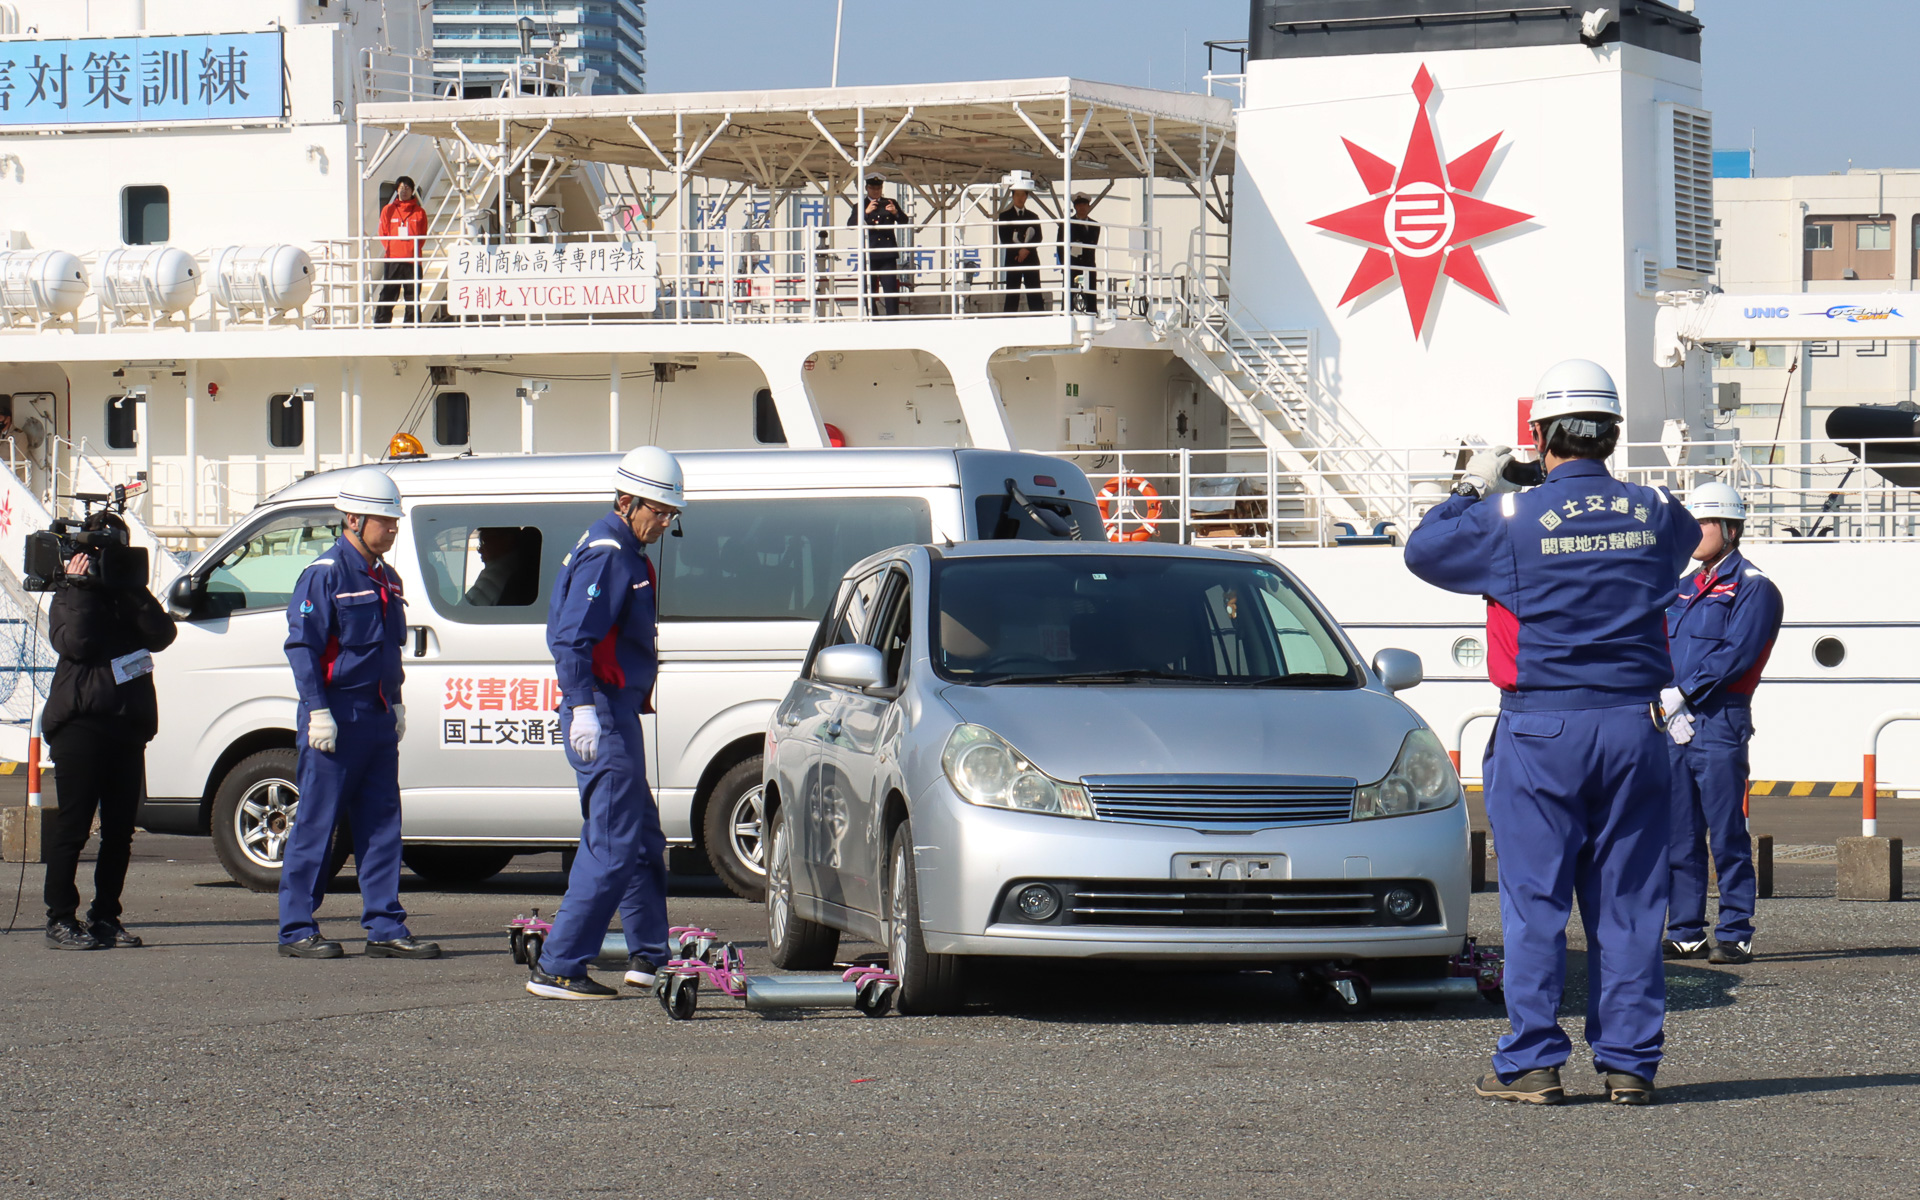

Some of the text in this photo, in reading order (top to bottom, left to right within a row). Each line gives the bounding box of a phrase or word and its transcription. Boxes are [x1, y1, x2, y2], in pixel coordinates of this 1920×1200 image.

[459, 247, 646, 274] 弓削商船高等専門学校
[459, 284, 647, 309] 弓削丸 YUGE MARU
[1744, 307, 1789, 319] UNIC
[1541, 530, 1657, 554] 関東地方整備局
[444, 677, 563, 711] 災害復旧
[444, 718, 564, 745] 国土交通省
